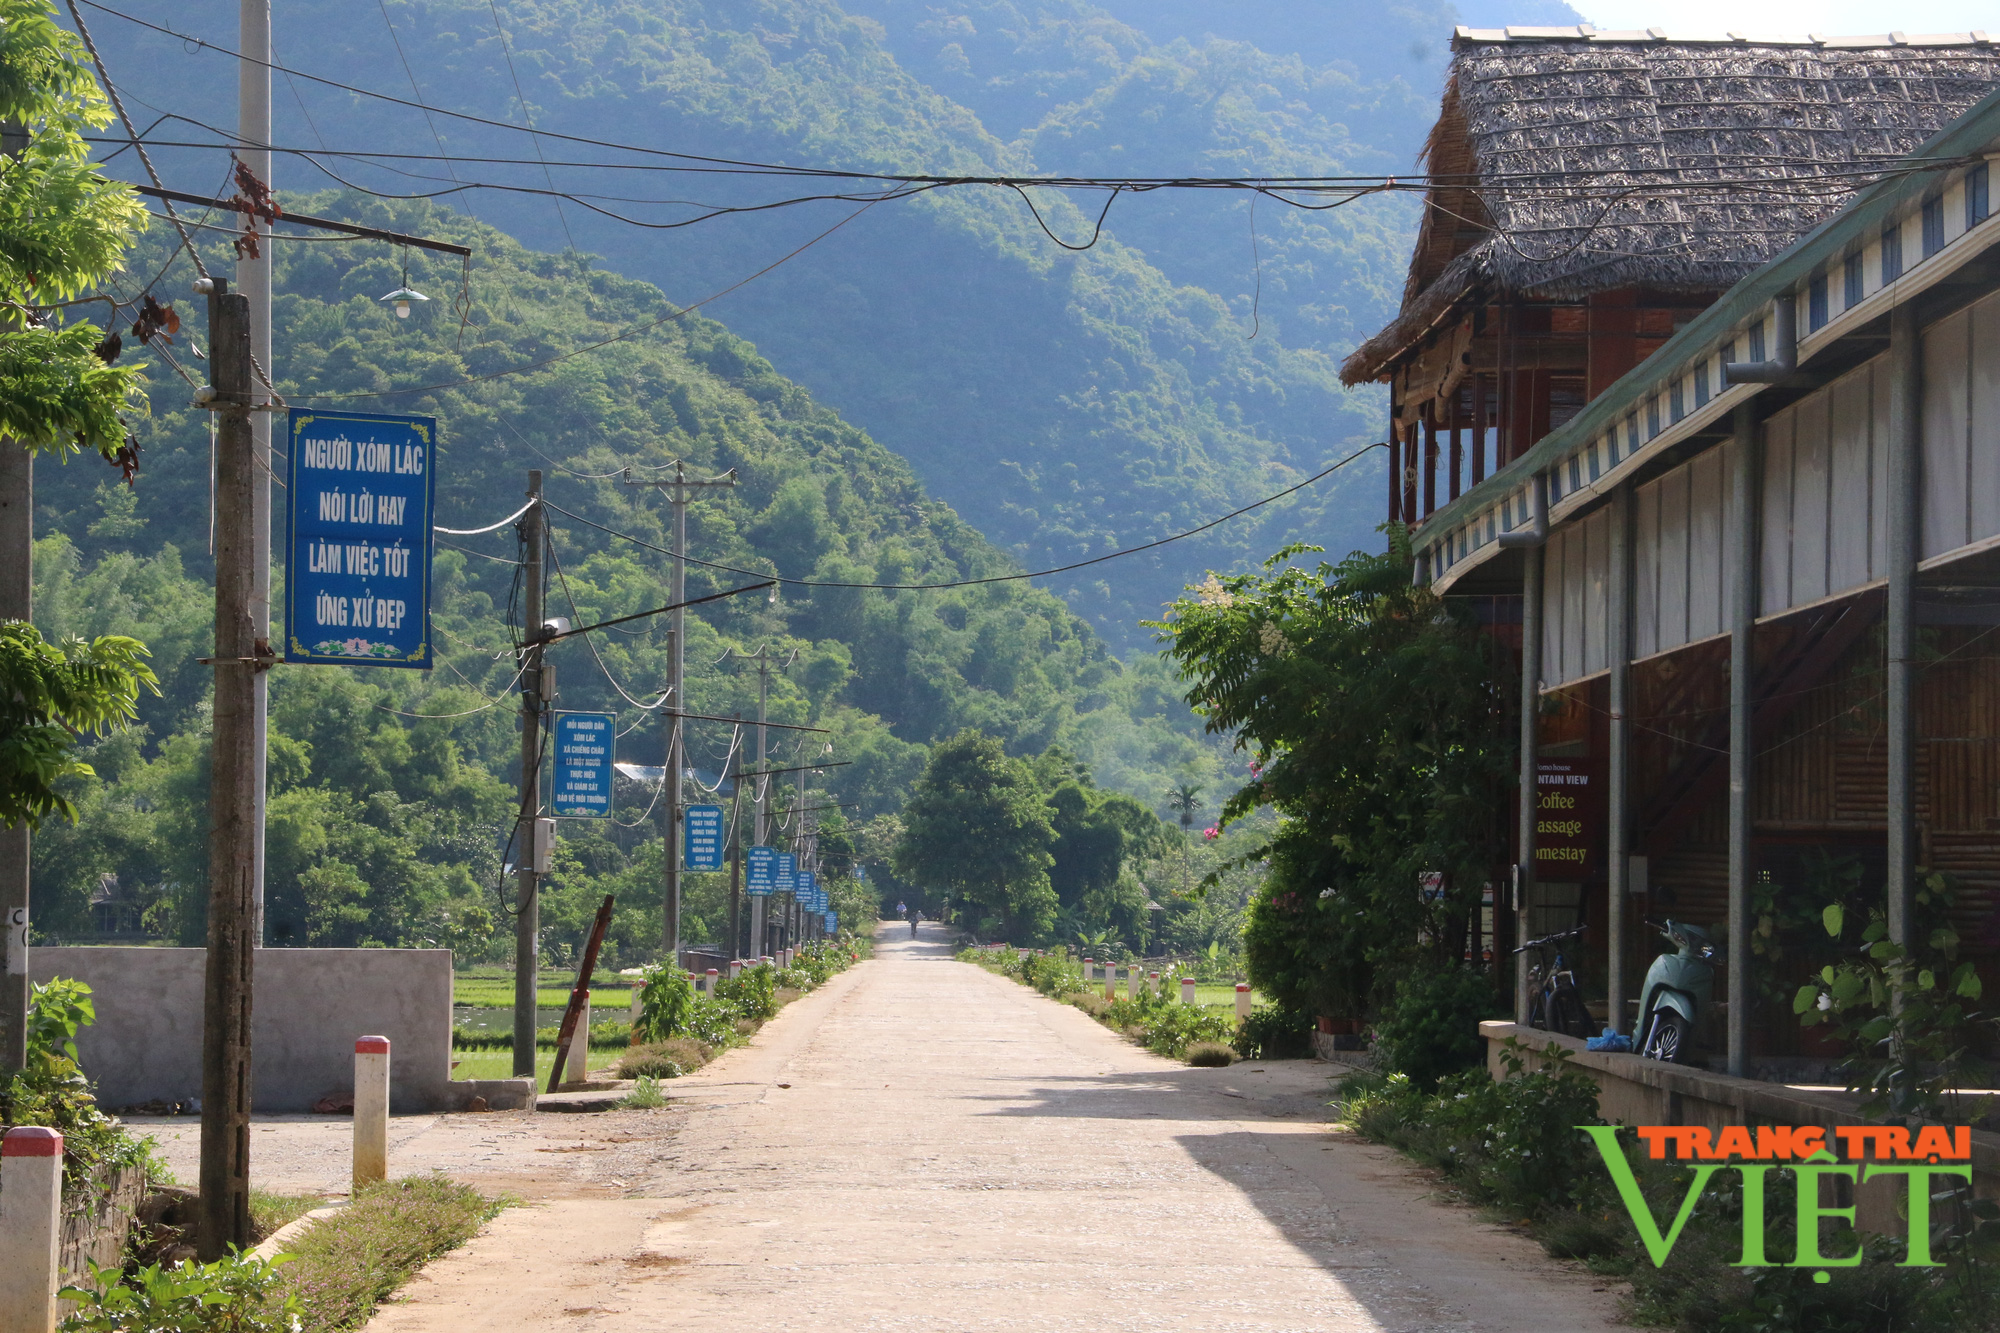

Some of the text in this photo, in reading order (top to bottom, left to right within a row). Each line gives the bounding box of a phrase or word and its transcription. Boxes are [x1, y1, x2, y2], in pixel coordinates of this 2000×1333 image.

[305, 434, 423, 476] NGƯỜI XÓM LÁC
[319, 486, 406, 526] NÓI LỜI HAY
[309, 538, 410, 582] LÀM VIỆC TỐT
[316, 588, 406, 635] ỨNG XỬ ĐẸP
[578, 720, 593, 730] NGƯỜI
[594, 720, 605, 731] DÂN
[574, 732, 596, 742] XÓM LÁC
[591, 745, 605, 755] CHÂU
[566, 756, 573, 765] LÀ
[570, 769, 596, 780] THỰC HIỆN
[1566, 775, 1588, 785] VIEW
[566, 781, 598, 791] VÀ GIÁM SÁT
[557, 791, 607, 804] BẢO VỆ MÔI TRƯỜNG
